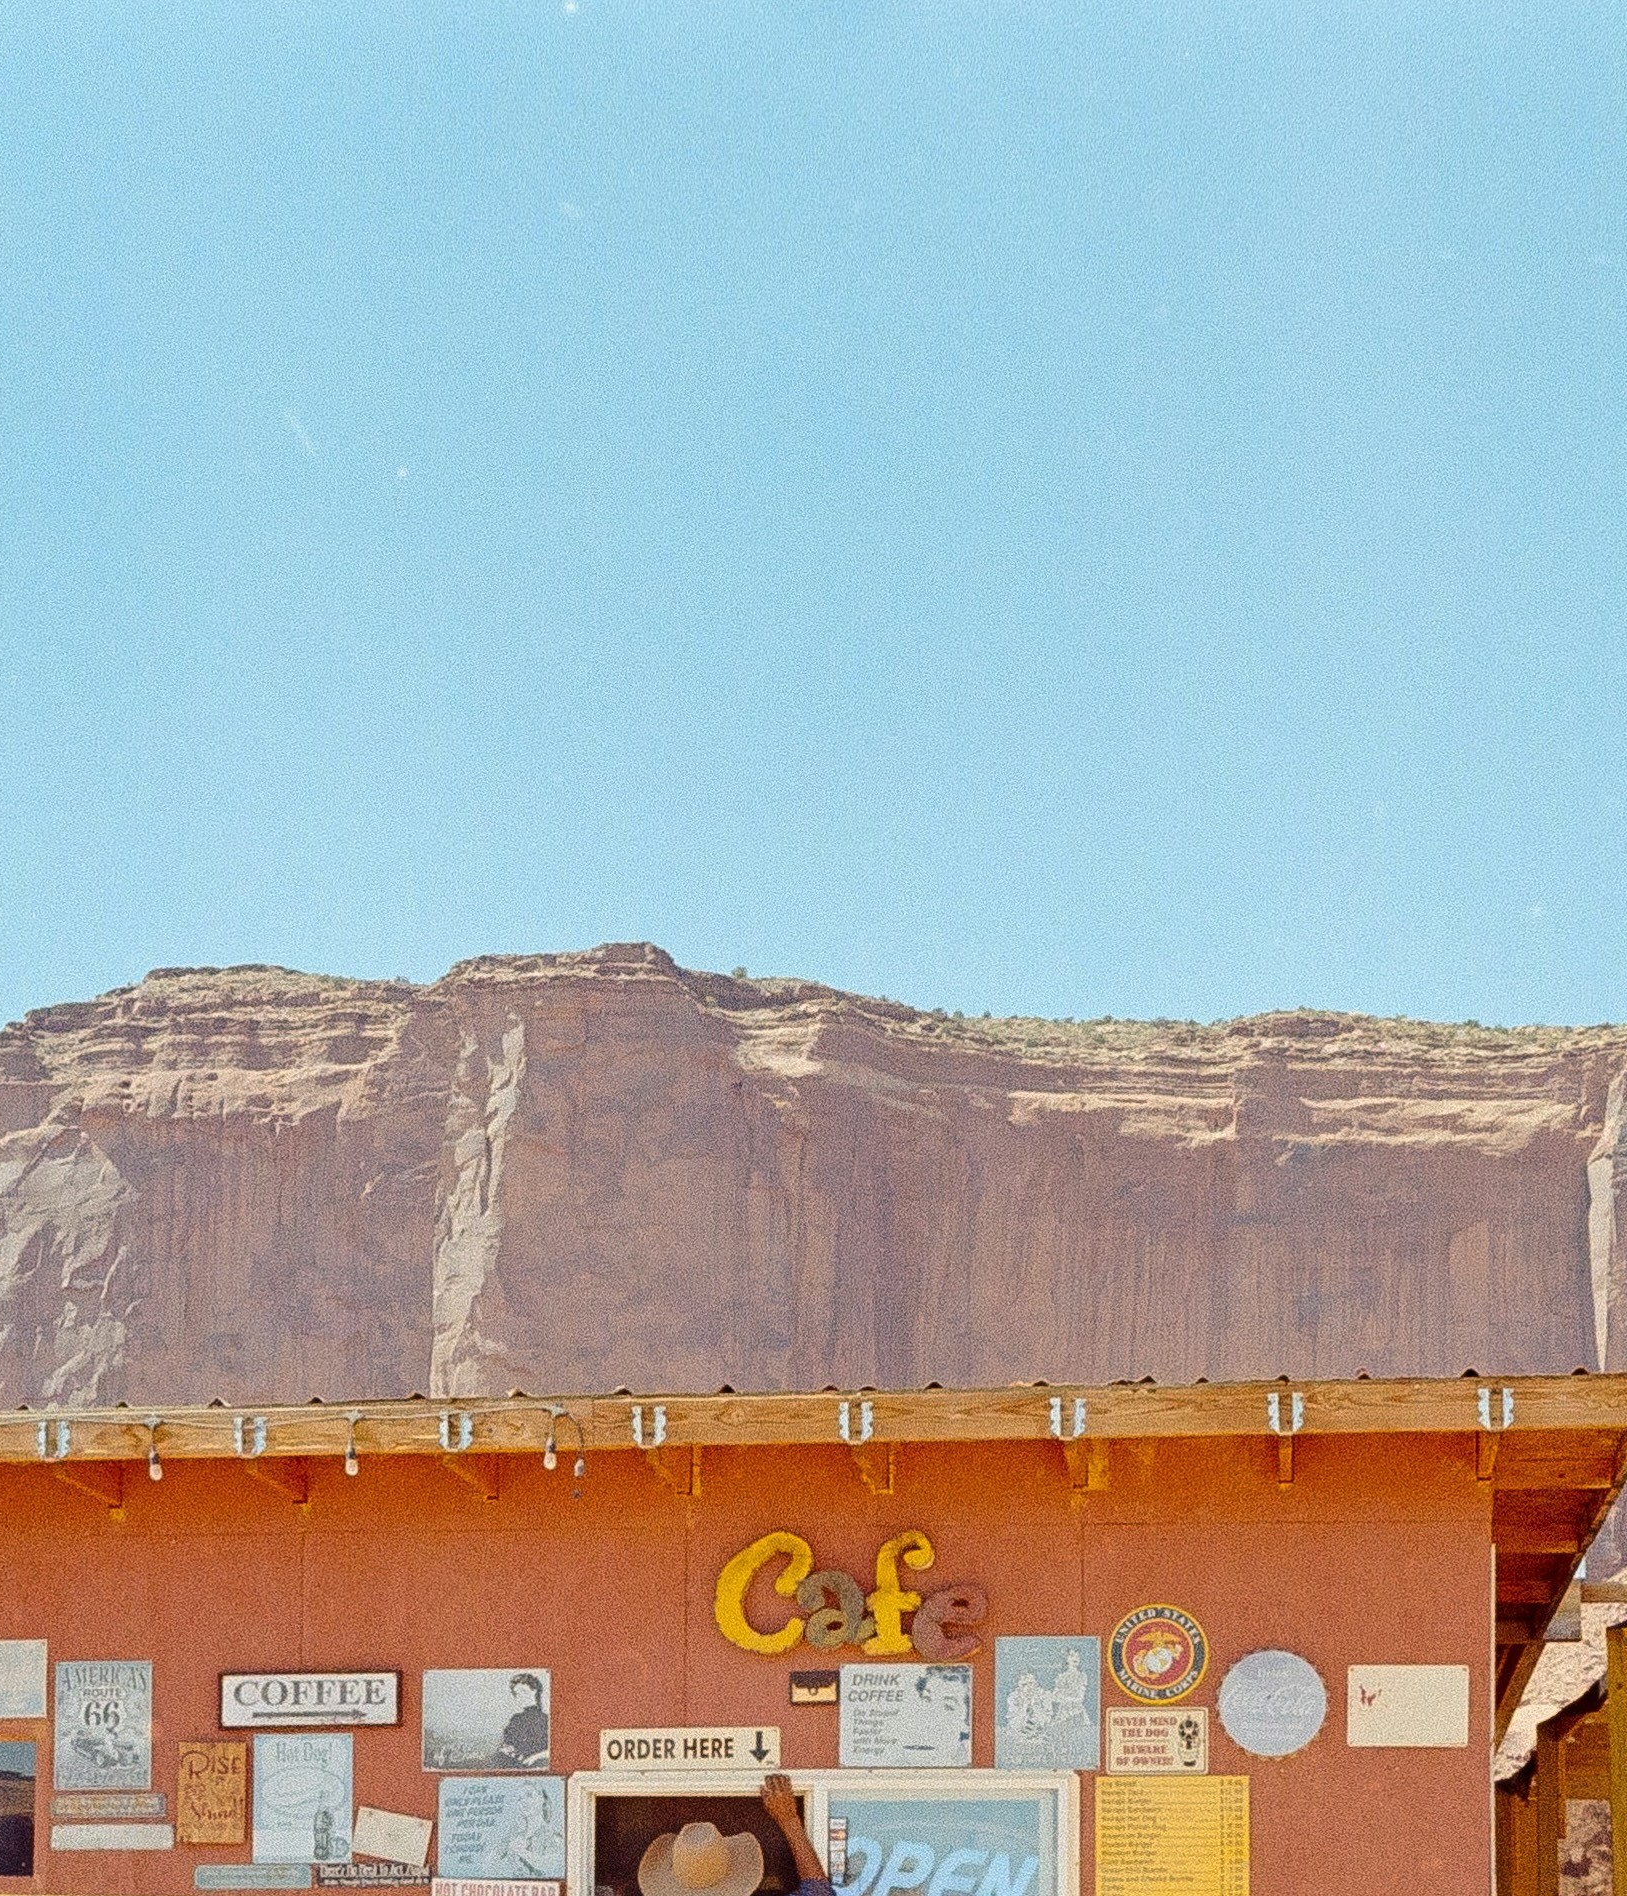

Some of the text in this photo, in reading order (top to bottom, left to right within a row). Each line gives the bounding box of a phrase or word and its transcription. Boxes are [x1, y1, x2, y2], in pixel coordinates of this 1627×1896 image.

[714, 1530, 988, 1661] Cafe
[1115, 1609, 1201, 1644] UNITED STATES
[852, 1673, 900, 1686] DRINK
[1118, 1670, 1198, 1698] MARINE CORPS
[83, 1688, 122, 1698] ROUTE
[234, 1679, 386, 1706] COFFEE
[848, 1690, 904, 1702] COFFEE
[84, 1702, 120, 1726] 66
[1113, 1717, 1178, 1726] NEVER MIND
[1121, 1729, 1169, 1737] THE DOG
[607, 1738, 734, 1760] ORDER HERE
[1123, 1745, 1167, 1754] BEWARE
[1116, 1757, 1128, 1765] OF
